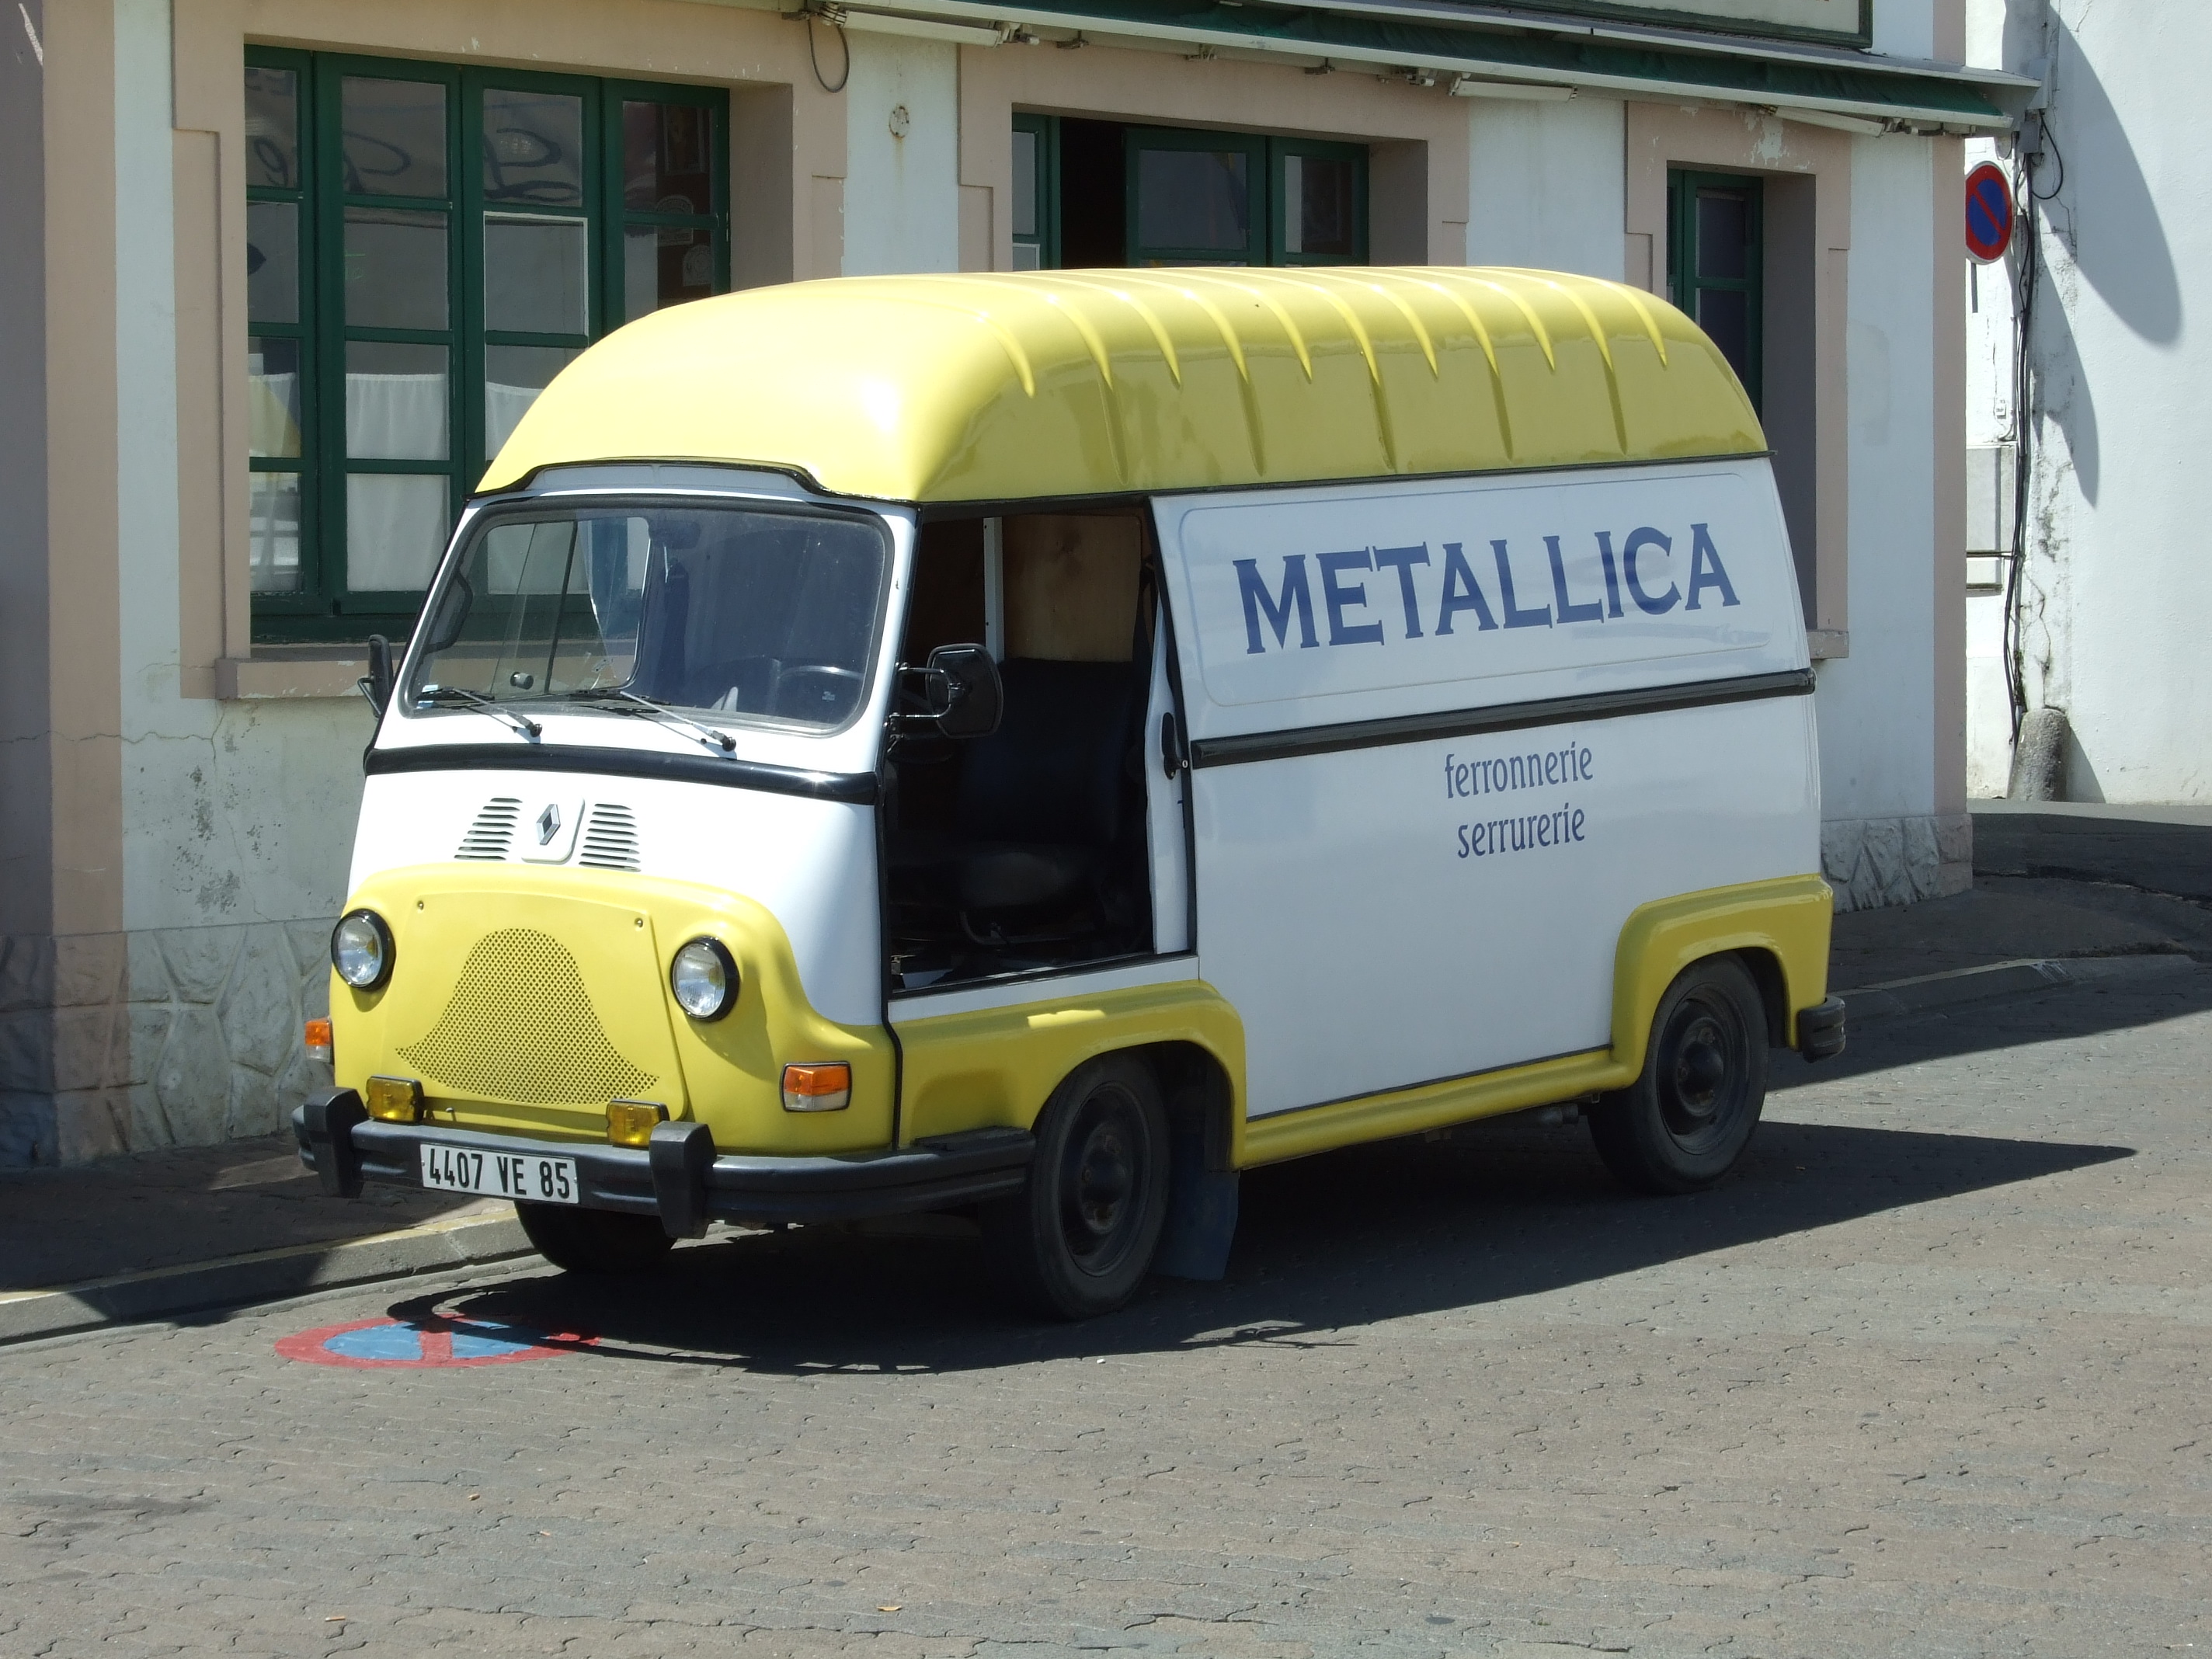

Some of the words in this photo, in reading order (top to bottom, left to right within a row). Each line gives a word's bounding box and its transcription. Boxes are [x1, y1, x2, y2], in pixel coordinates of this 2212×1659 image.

[1232, 523, 1741, 655] METALLICA
[1445, 740, 1594, 799] ferronnerie
[1456, 802, 1586, 860] serrurerie
[429, 1148, 483, 1190] 4407
[496, 1155, 527, 1196] VE
[538, 1160, 570, 1199] 85
